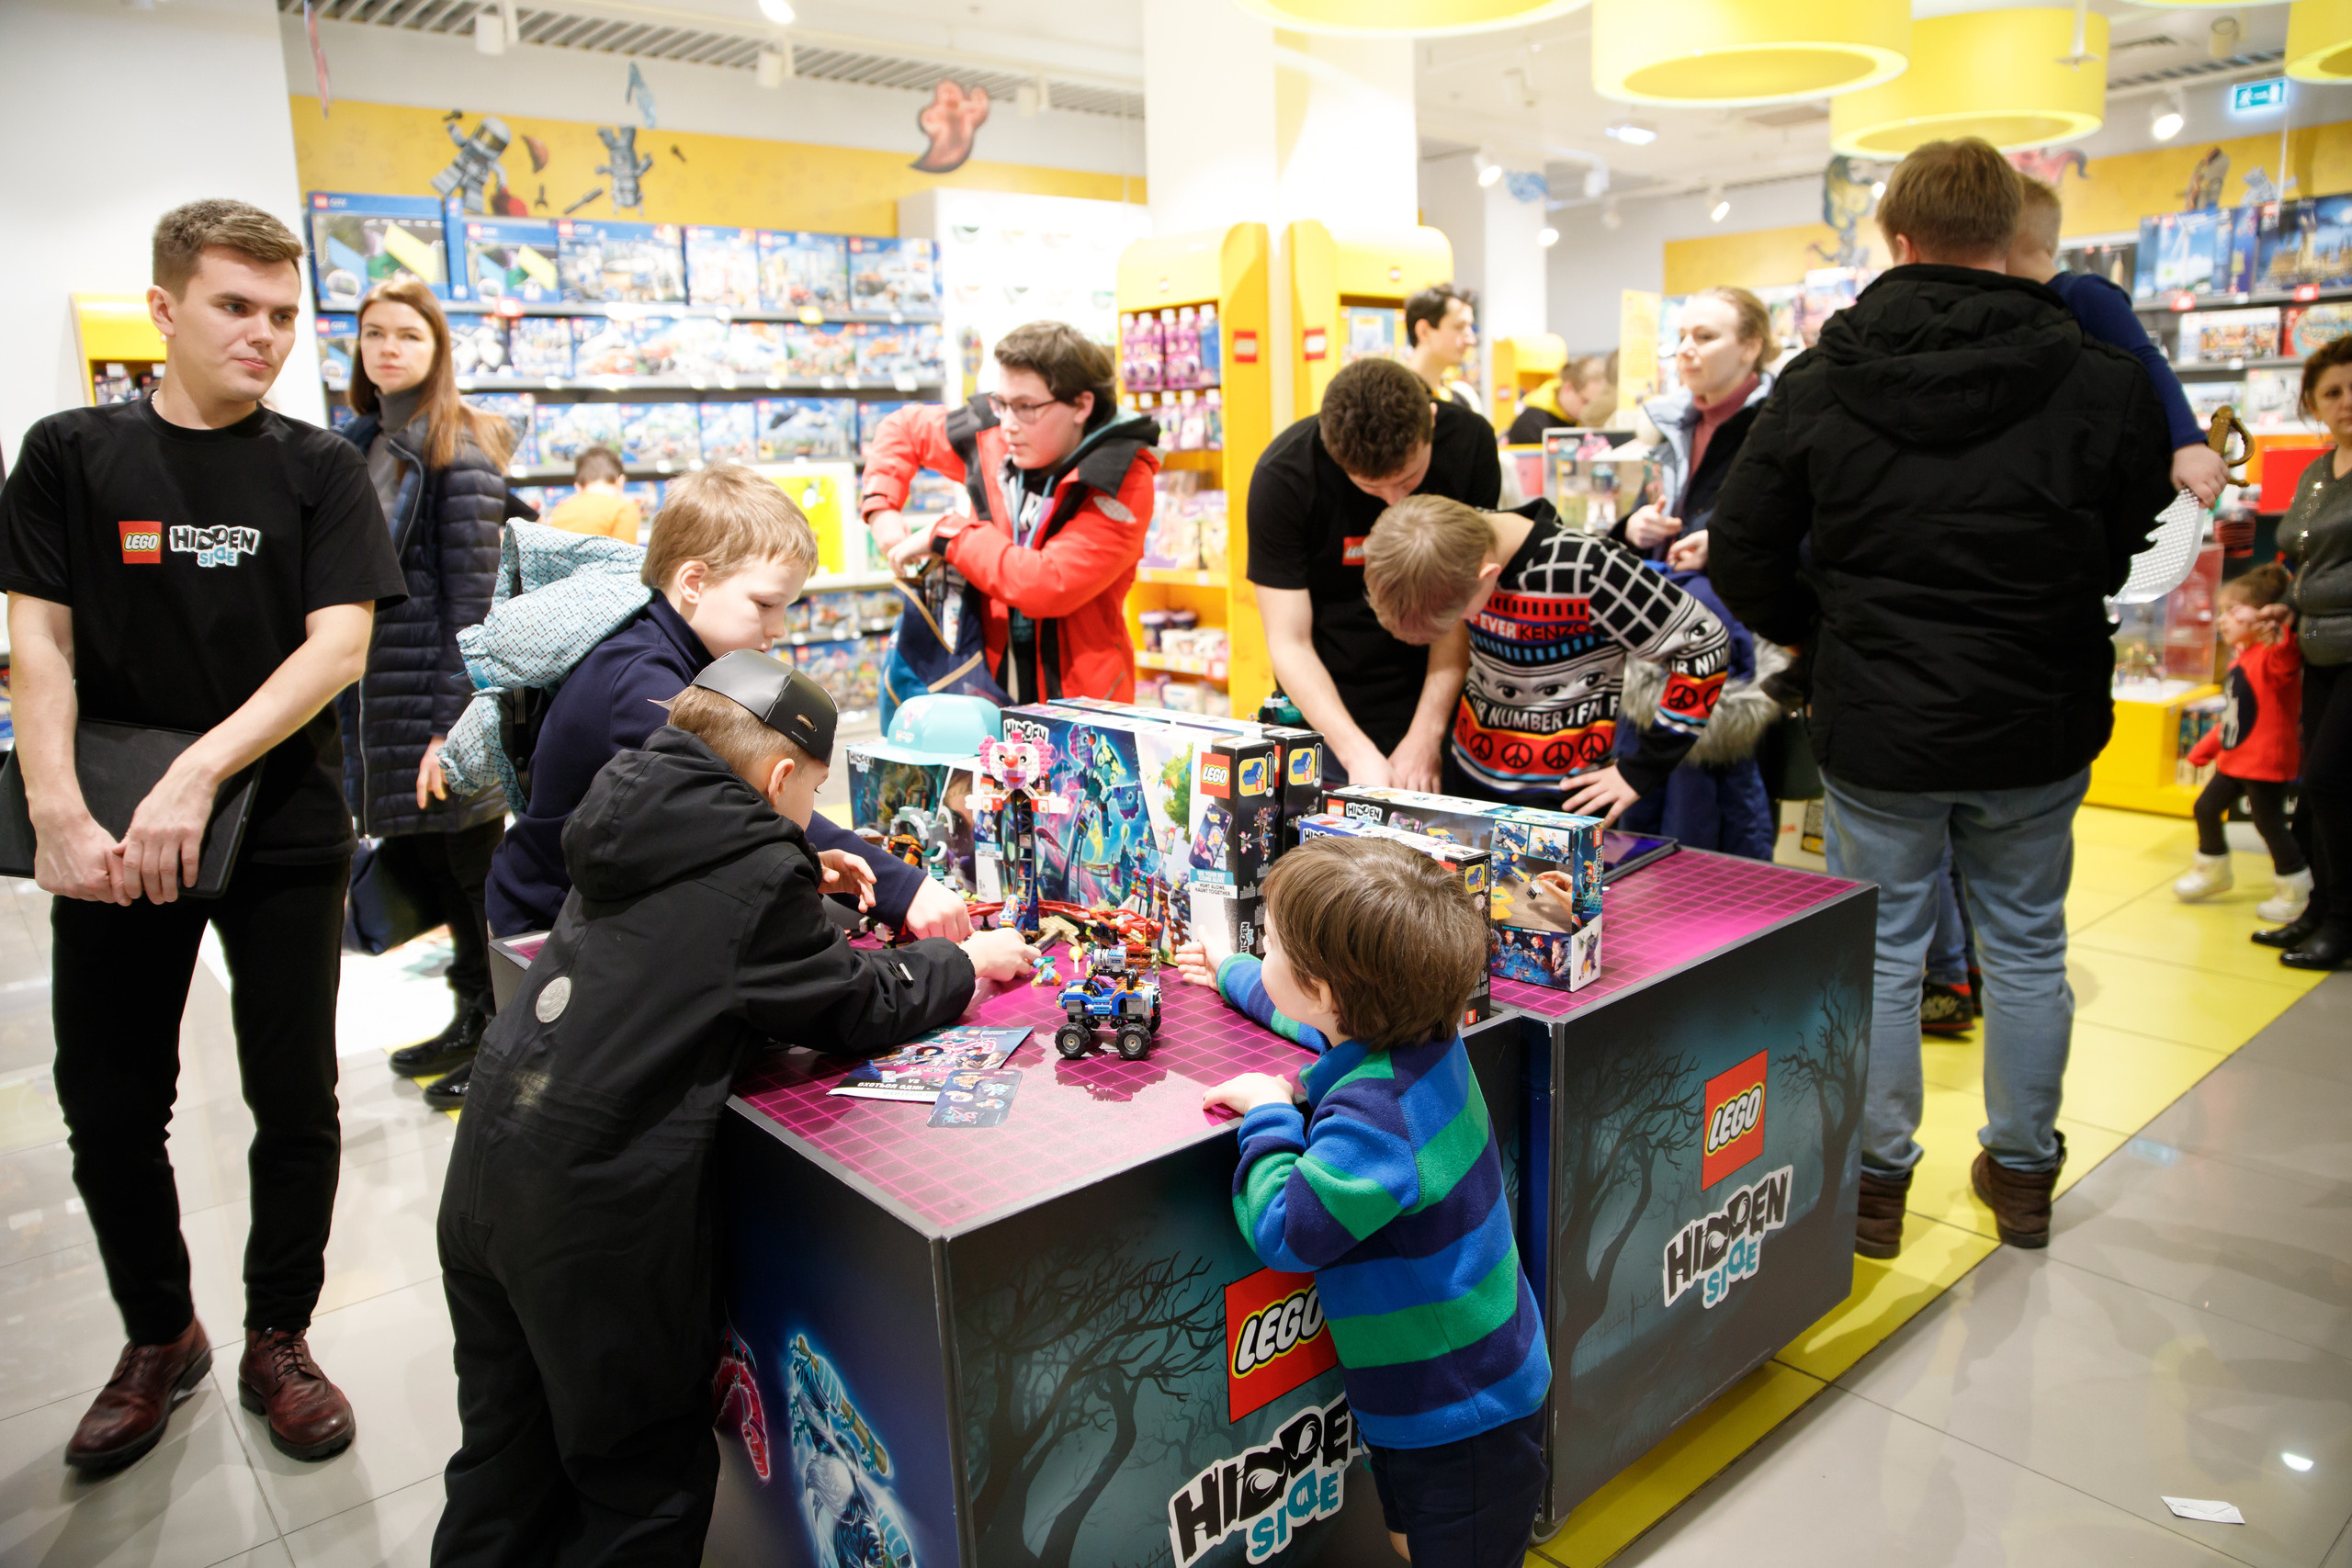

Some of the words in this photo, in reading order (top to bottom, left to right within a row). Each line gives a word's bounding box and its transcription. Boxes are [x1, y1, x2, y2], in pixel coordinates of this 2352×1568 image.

[124, 533, 159, 550] LEGO
[172, 526, 257, 554] HIDDEN
[198, 547, 235, 564] SIDE
[1520, 623, 1589, 641] KENZO
[1488, 706, 1564, 732] NUMBER
[1566, 707, 1575, 726] 1
[1203, 766, 1227, 784] LEGO
[1348, 805, 1381, 820] HIDDEN
[1709, 1088, 1761, 1151] LEGO
[1667, 1170, 1790, 1301] HIDDEN
[1706, 1236, 1758, 1303] SIDE
[1174, 1398, 1358, 1563] HIDDE
[1251, 1469, 1339, 1558] SIDE
